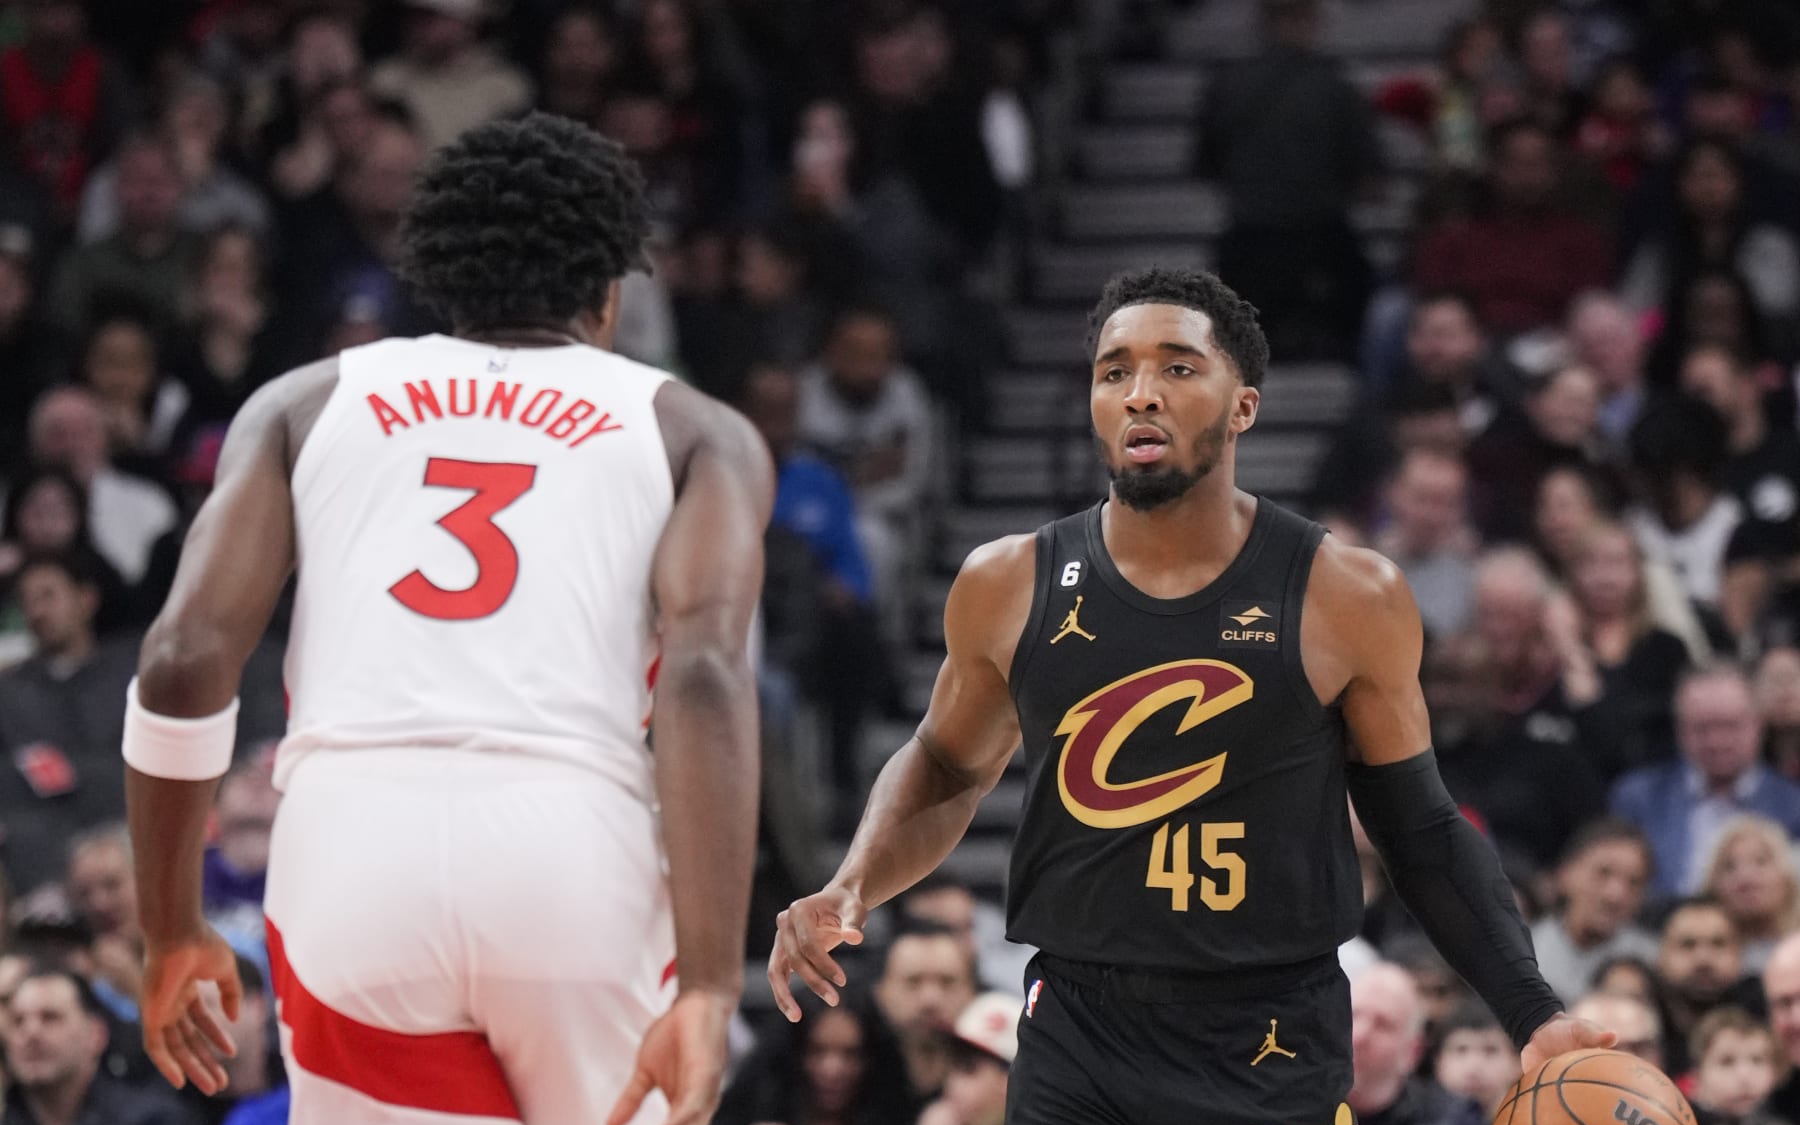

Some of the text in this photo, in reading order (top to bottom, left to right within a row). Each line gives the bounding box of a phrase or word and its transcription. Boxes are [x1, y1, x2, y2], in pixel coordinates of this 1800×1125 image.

[366, 378, 624, 449] ANUNOBY
[387, 457, 538, 621] 3
[1060, 561, 1082, 587] 6
[1221, 630, 1277, 643] CLIFFS
[1053, 658, 1254, 829] C
[1145, 822, 1246, 912] 45
